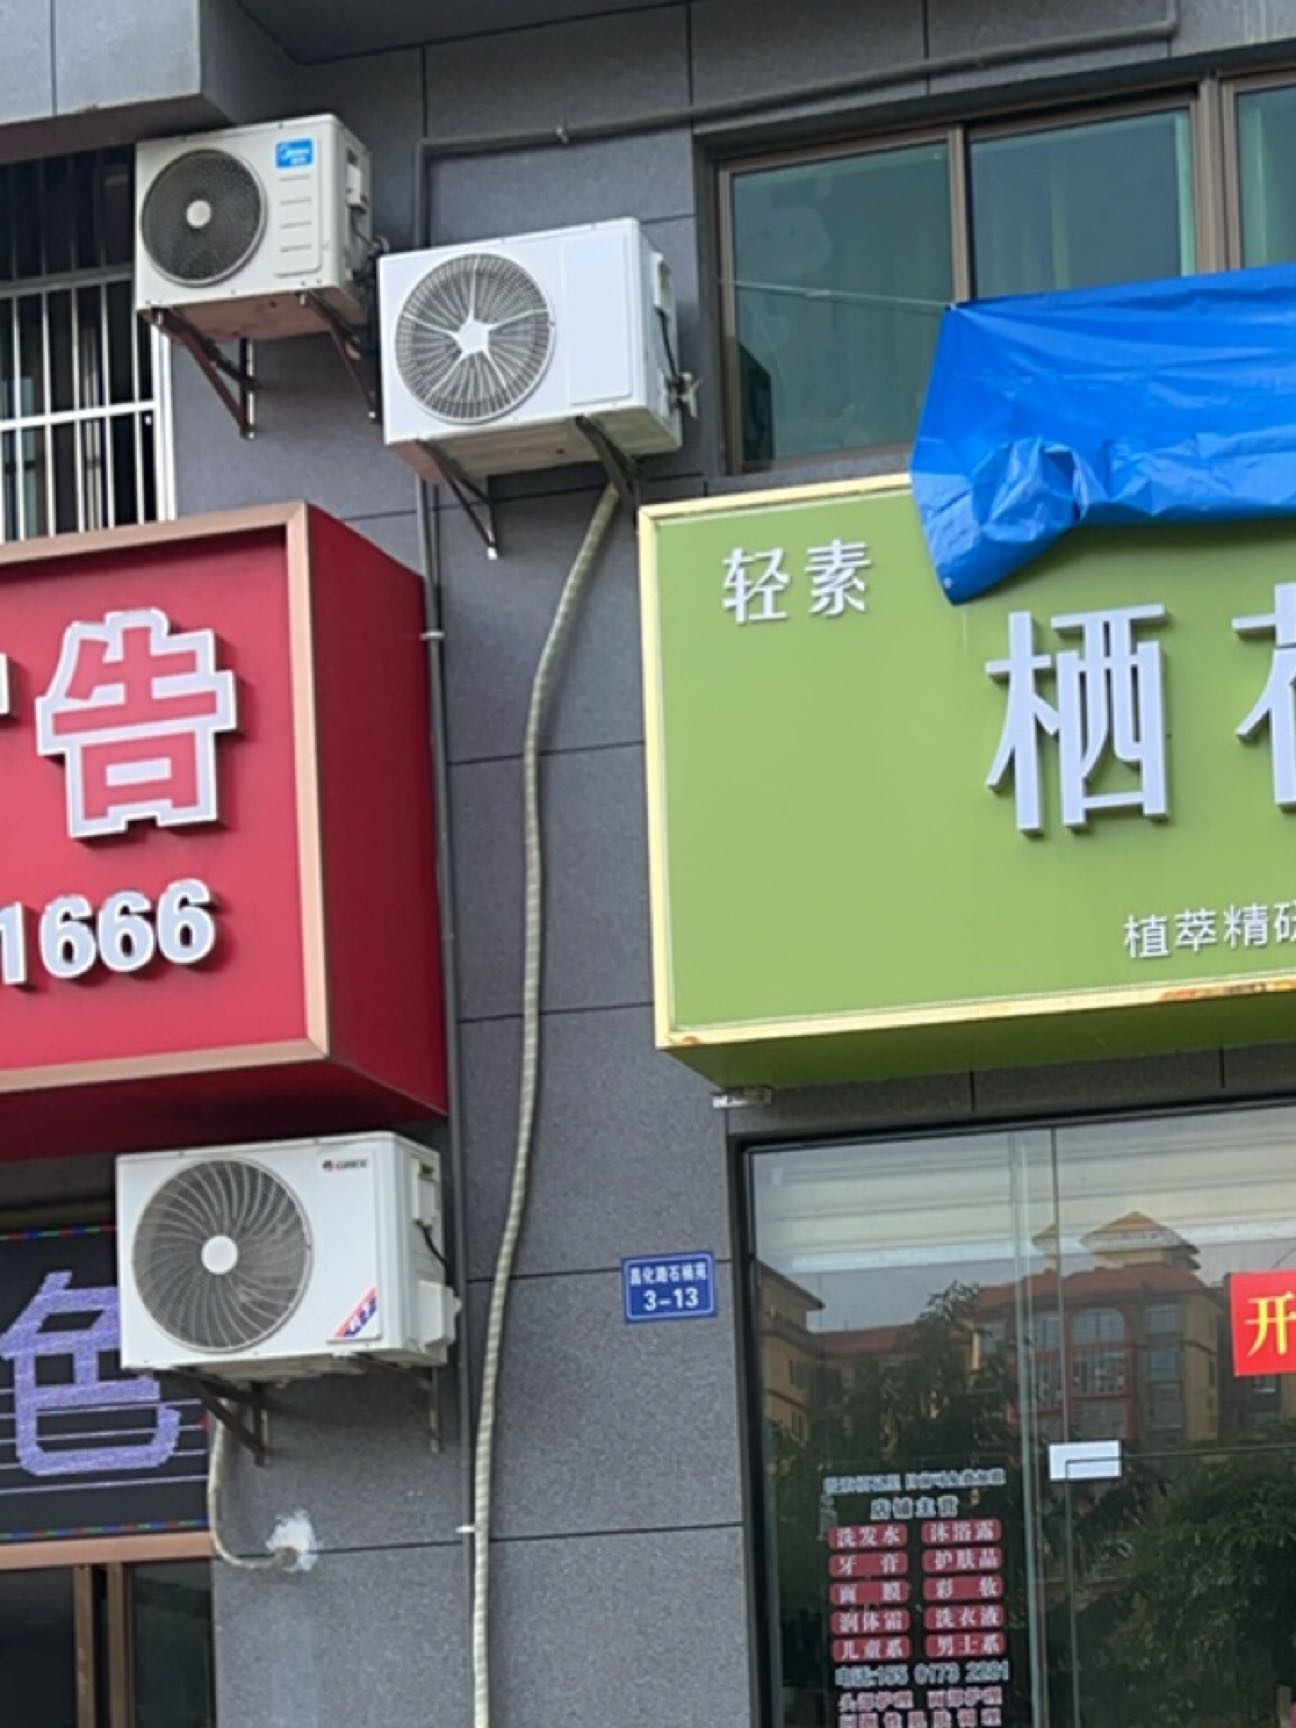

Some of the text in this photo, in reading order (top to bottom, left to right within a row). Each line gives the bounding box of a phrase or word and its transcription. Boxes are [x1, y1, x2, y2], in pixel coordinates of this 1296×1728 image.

[722, 538, 872, 627] 轻素
[0, 606, 238, 840] 告
[643, 1286, 699, 1311] 3-13
